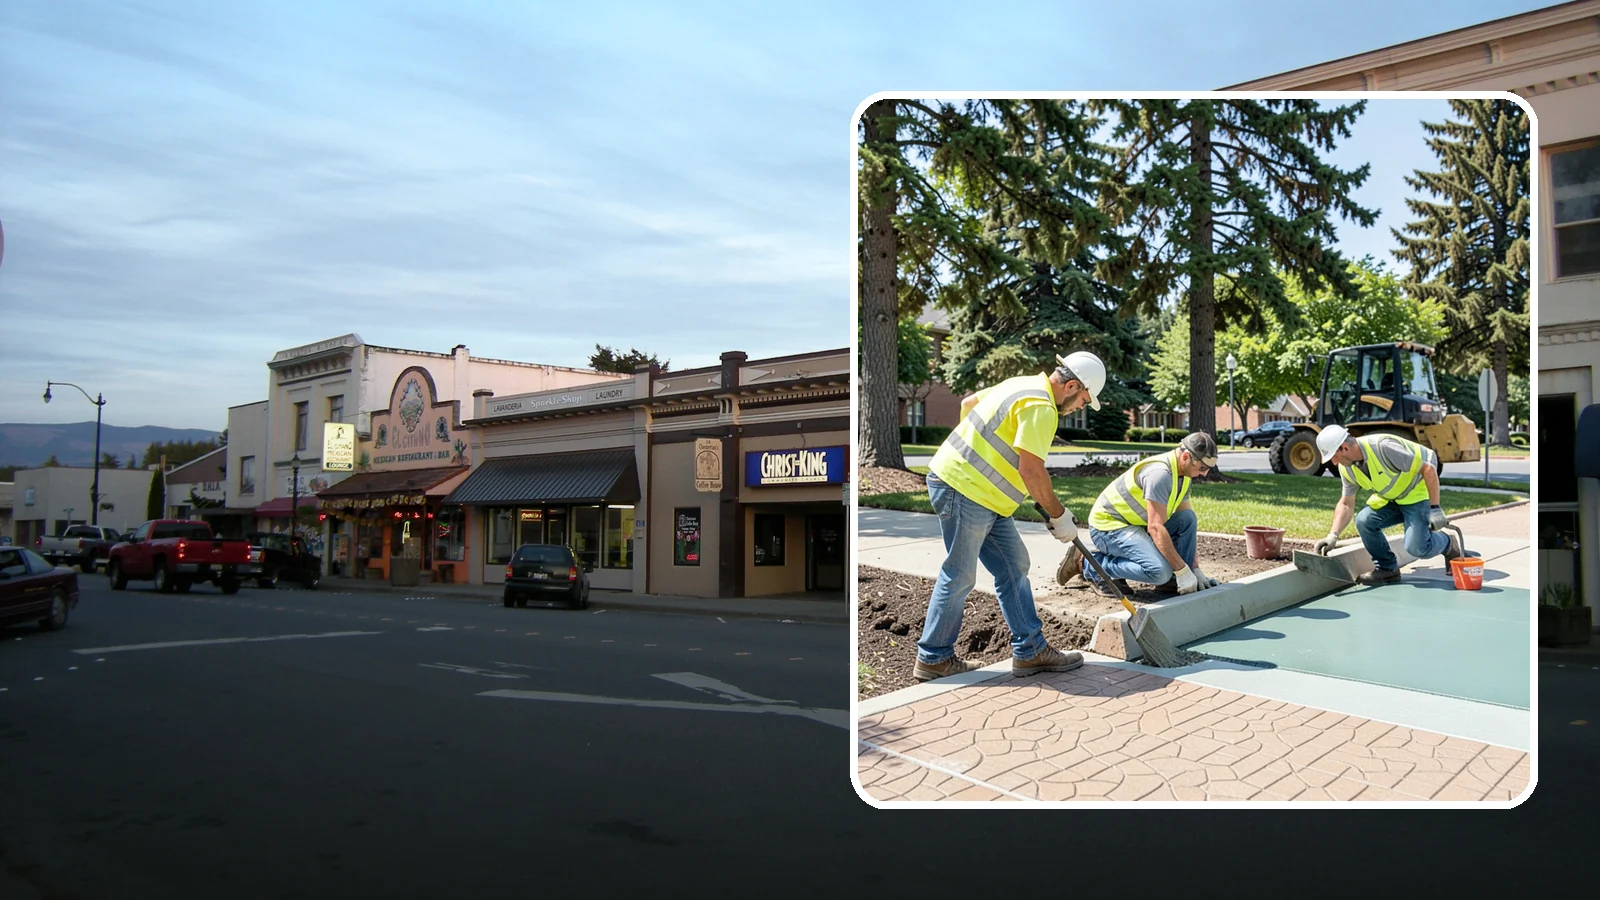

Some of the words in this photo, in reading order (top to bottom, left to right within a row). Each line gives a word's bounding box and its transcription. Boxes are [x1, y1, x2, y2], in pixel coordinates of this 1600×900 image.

[493, 402, 522, 413] LAVANDERIA
[530, 396, 560, 408] Sparkle
[560, 394, 583, 404] Shop
[595, 389, 624, 400] LAUNDRY
[373, 454, 396, 464] MEXICAN
[397, 451, 434, 462] RESTAURANT
[437, 450, 450, 459] BAR
[761, 452, 797, 478] CHRIST
[799, 450, 827, 476] KING
